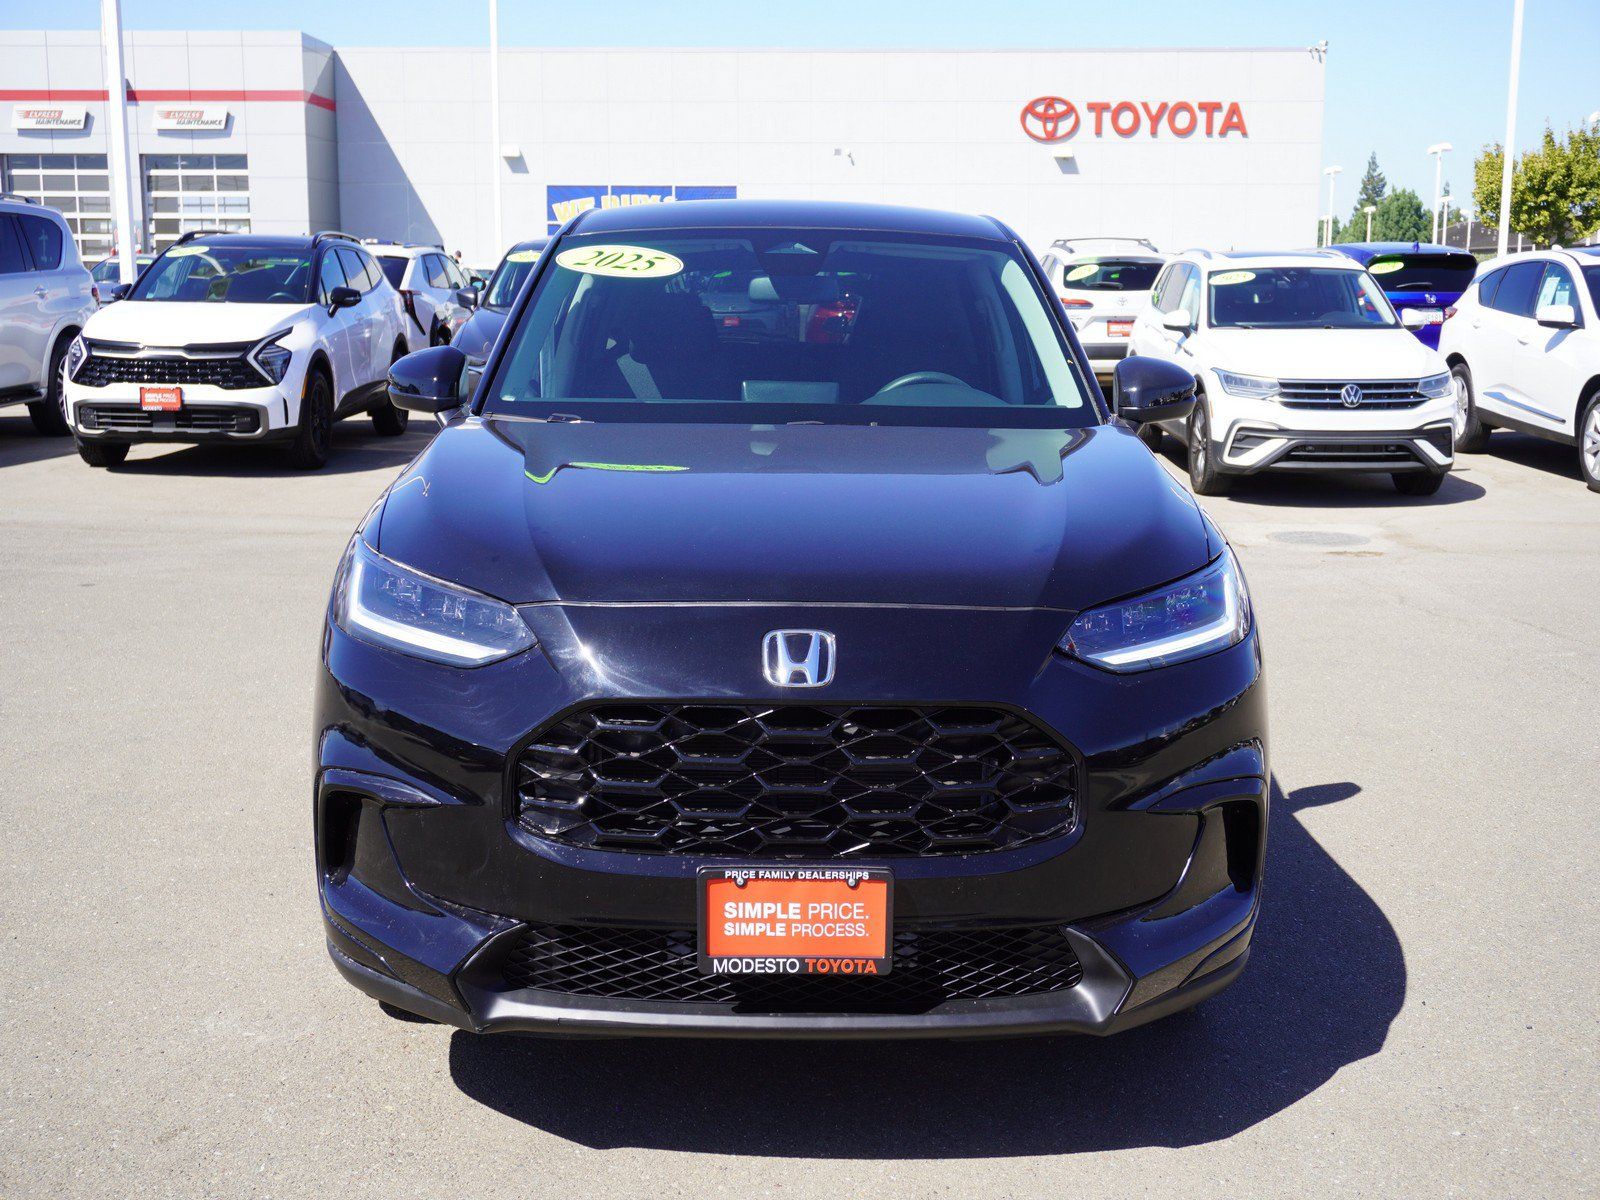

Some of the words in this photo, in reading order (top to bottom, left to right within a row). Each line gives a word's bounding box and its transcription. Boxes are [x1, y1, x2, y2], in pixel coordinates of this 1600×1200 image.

[1086, 101, 1248, 136] TOYOTA
[573, 250, 667, 272] 2025
[724, 870, 756, 879] PRICE
[758, 870, 795, 879] FAMILY
[797, 871, 870, 880] DEALERSHIPS
[723, 902, 802, 919] SIMPLE
[808, 903, 870, 920] PRICE.
[723, 922, 787, 936] SIMPLE
[791, 923, 870, 937] PROCESS.
[713, 958, 800, 974] MODESTO
[805, 959, 878, 974] TOYOTA
